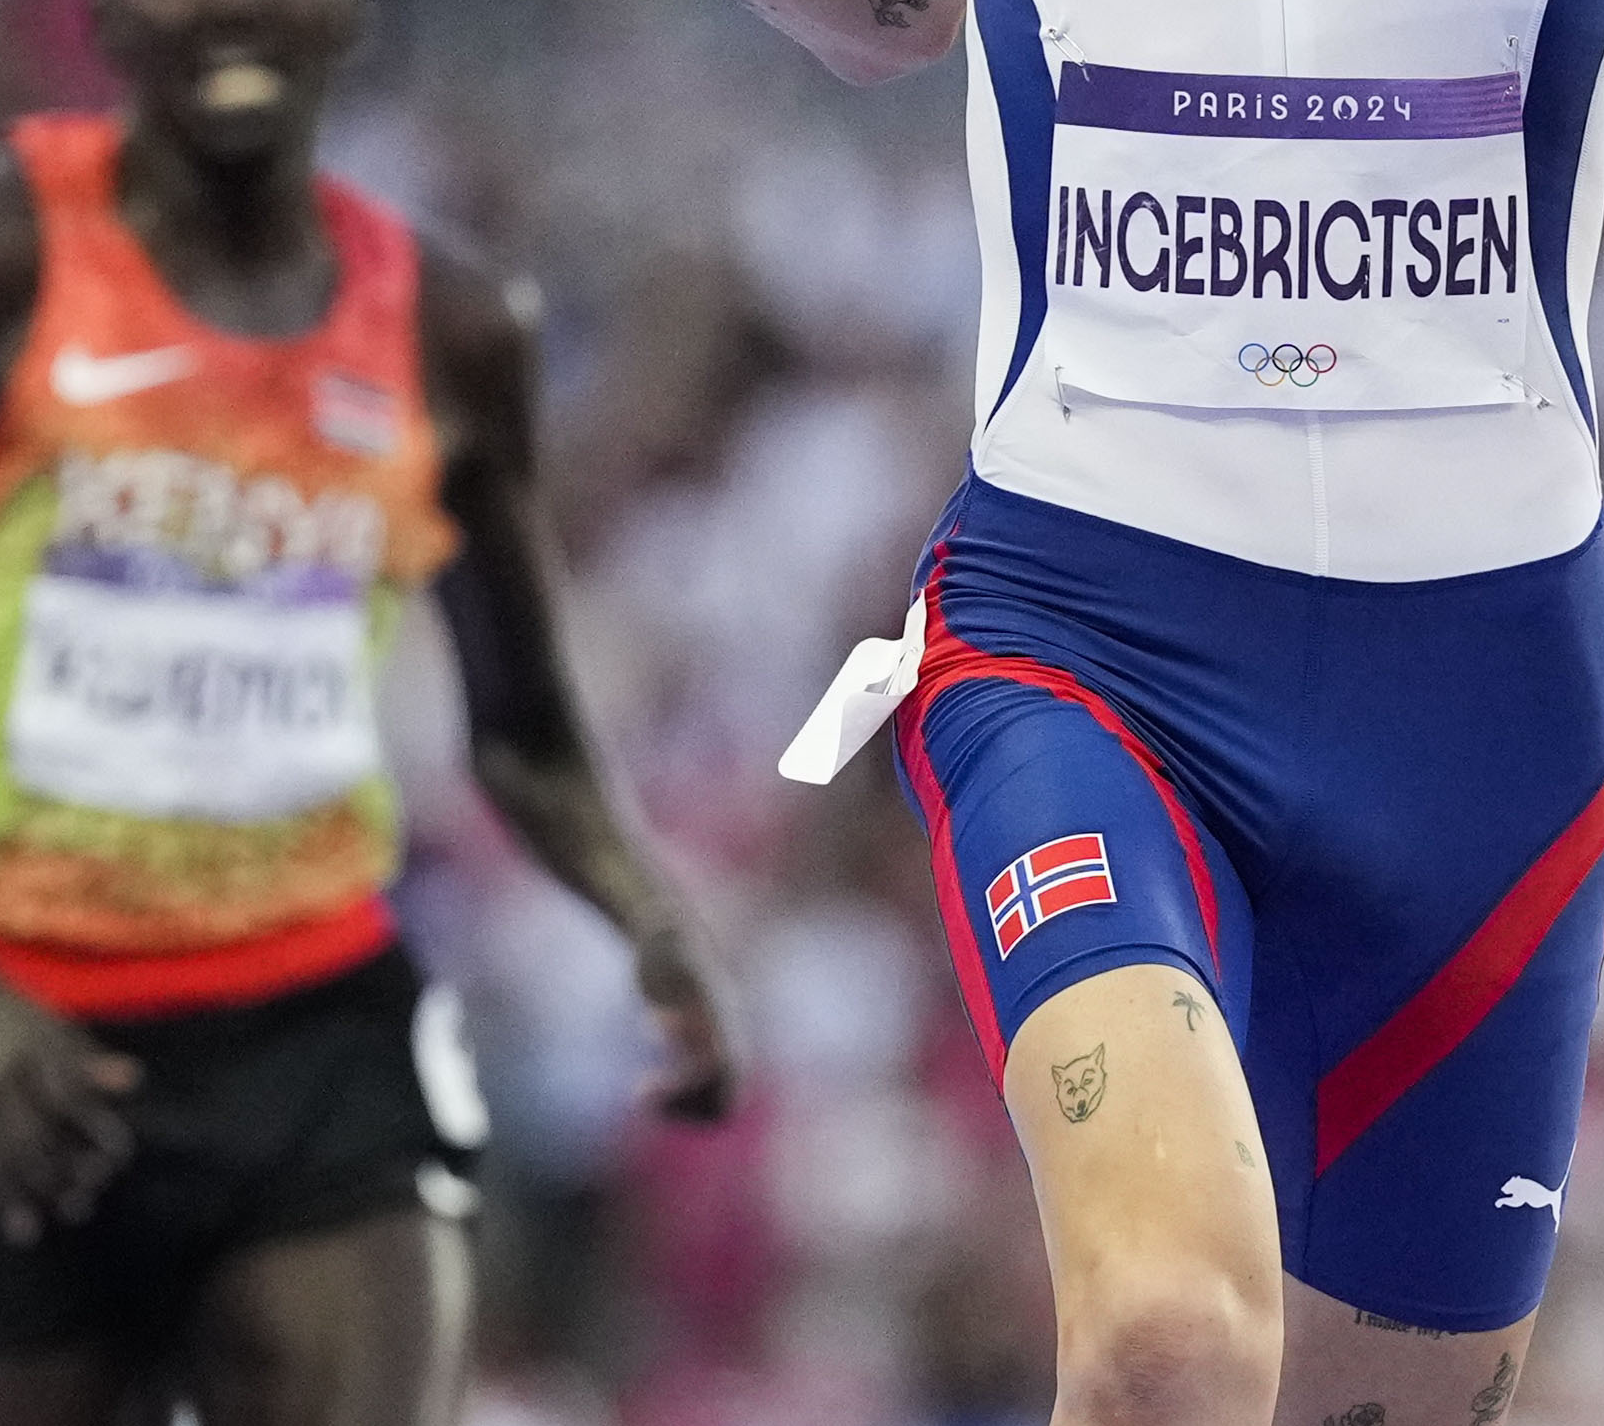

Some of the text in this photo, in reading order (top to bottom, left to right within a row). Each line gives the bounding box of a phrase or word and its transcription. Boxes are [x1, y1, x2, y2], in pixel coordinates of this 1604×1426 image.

[1173, 90, 1412, 122] PARIS 2024
[1055, 186, 1517, 301] INGEBRIGTSEN
